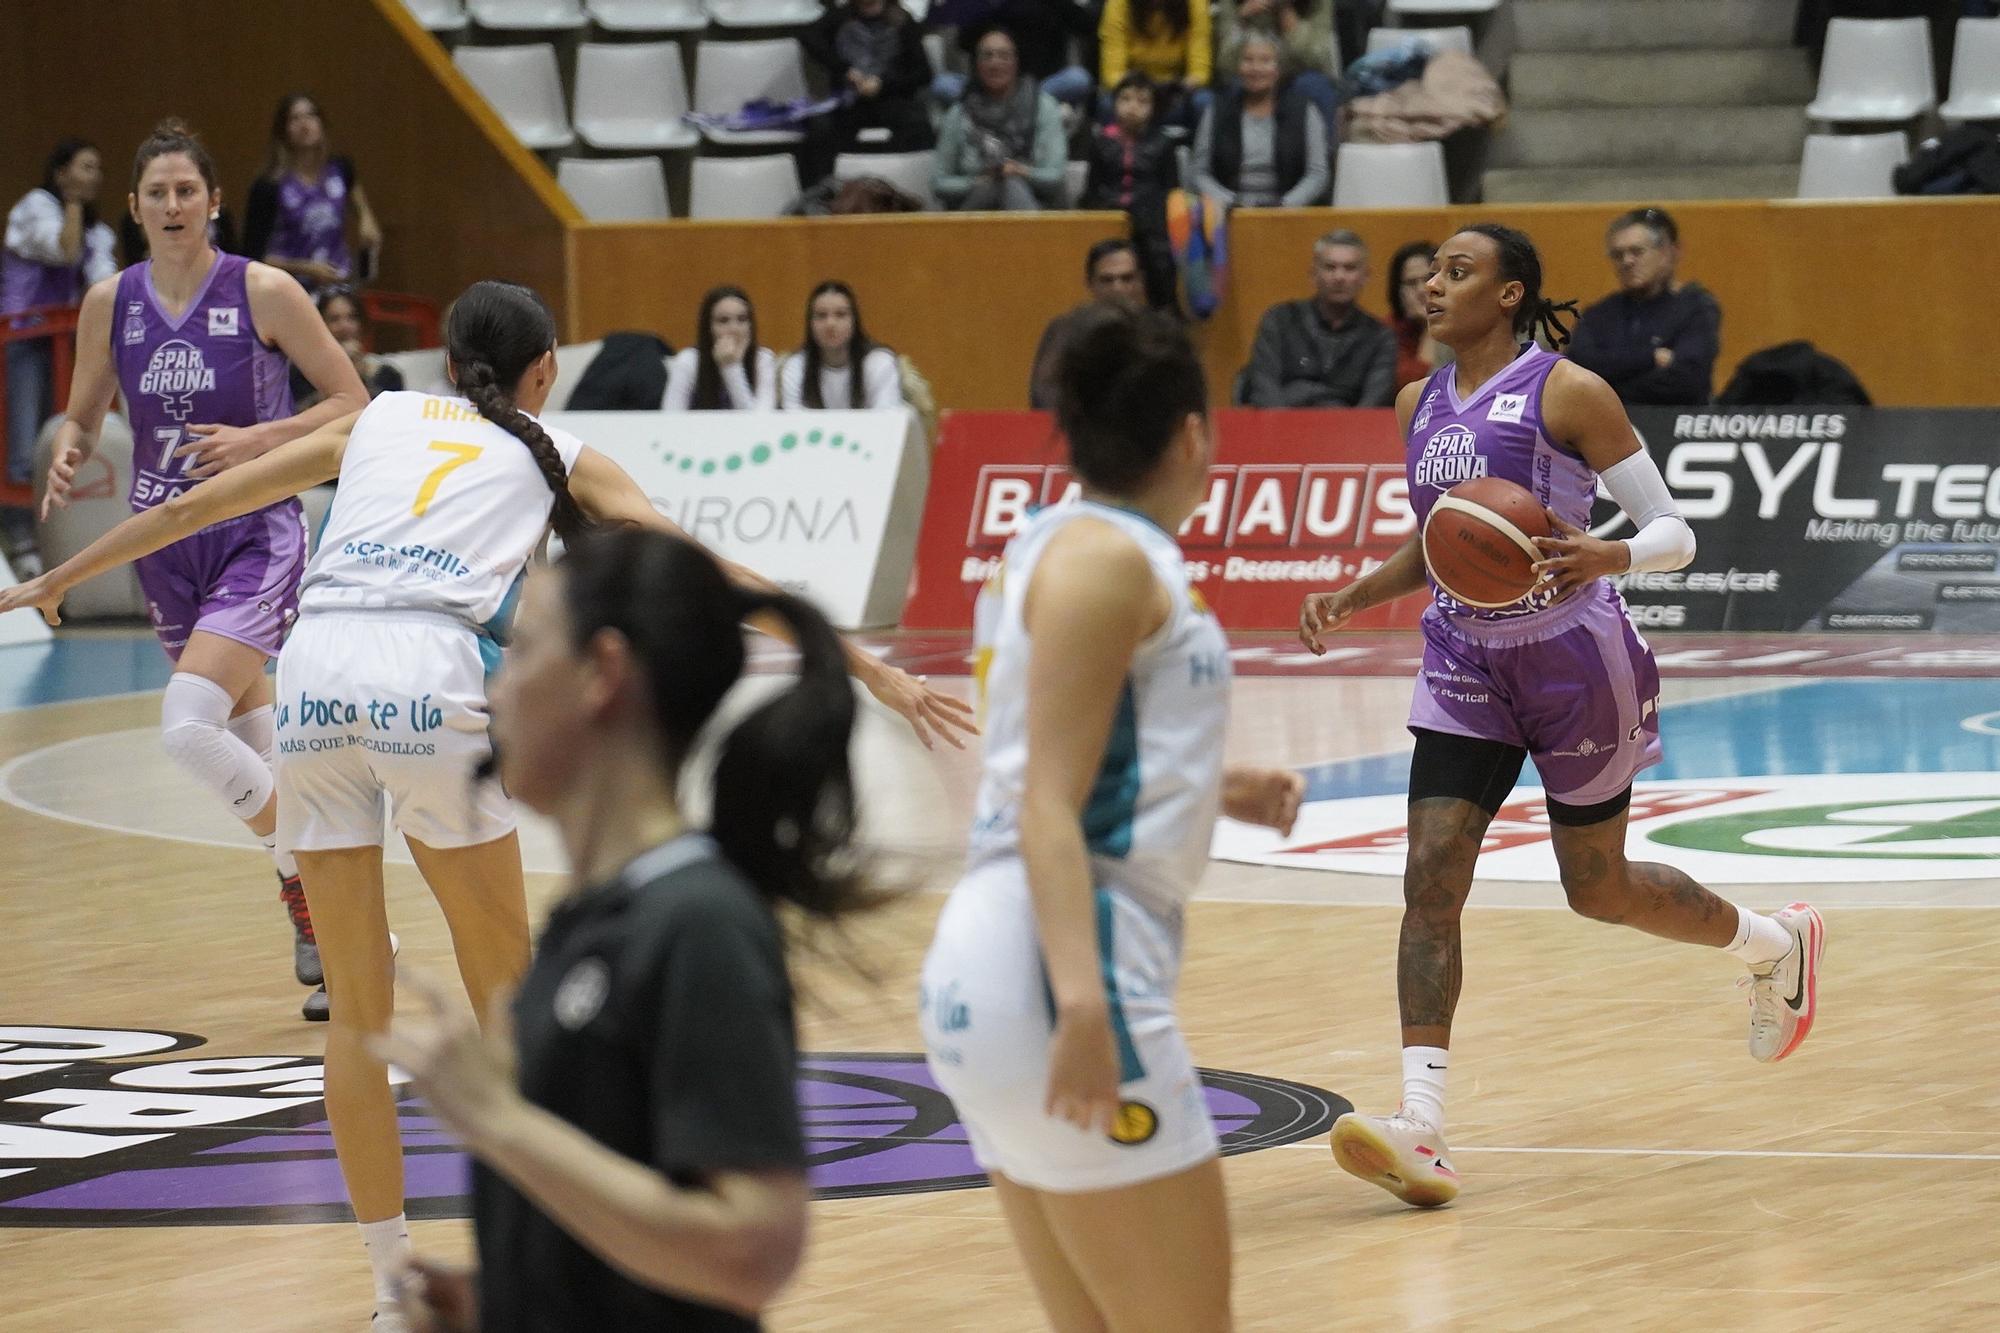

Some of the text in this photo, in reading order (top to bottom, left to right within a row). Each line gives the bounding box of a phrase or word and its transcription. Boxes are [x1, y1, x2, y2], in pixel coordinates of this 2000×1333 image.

[152, 350, 202, 370] SPAR
[140, 369, 215, 394] GIRONA
[1674, 414, 1846, 438] RENOVABLES
[1425, 433, 1474, 459] SPAR
[411, 440, 484, 517] 7
[1415, 456, 1487, 487] GIRONA
[1805, 519, 1899, 547] Making
[1903, 520, 1949, 542] the
[1223, 555, 1342, 582] Decoració
[300, 691, 358, 727] boca
[367, 700, 399, 731] te
[410, 694, 443, 732] lía
[280, 734, 435, 755] MÁS QUE BOCADILLOS
